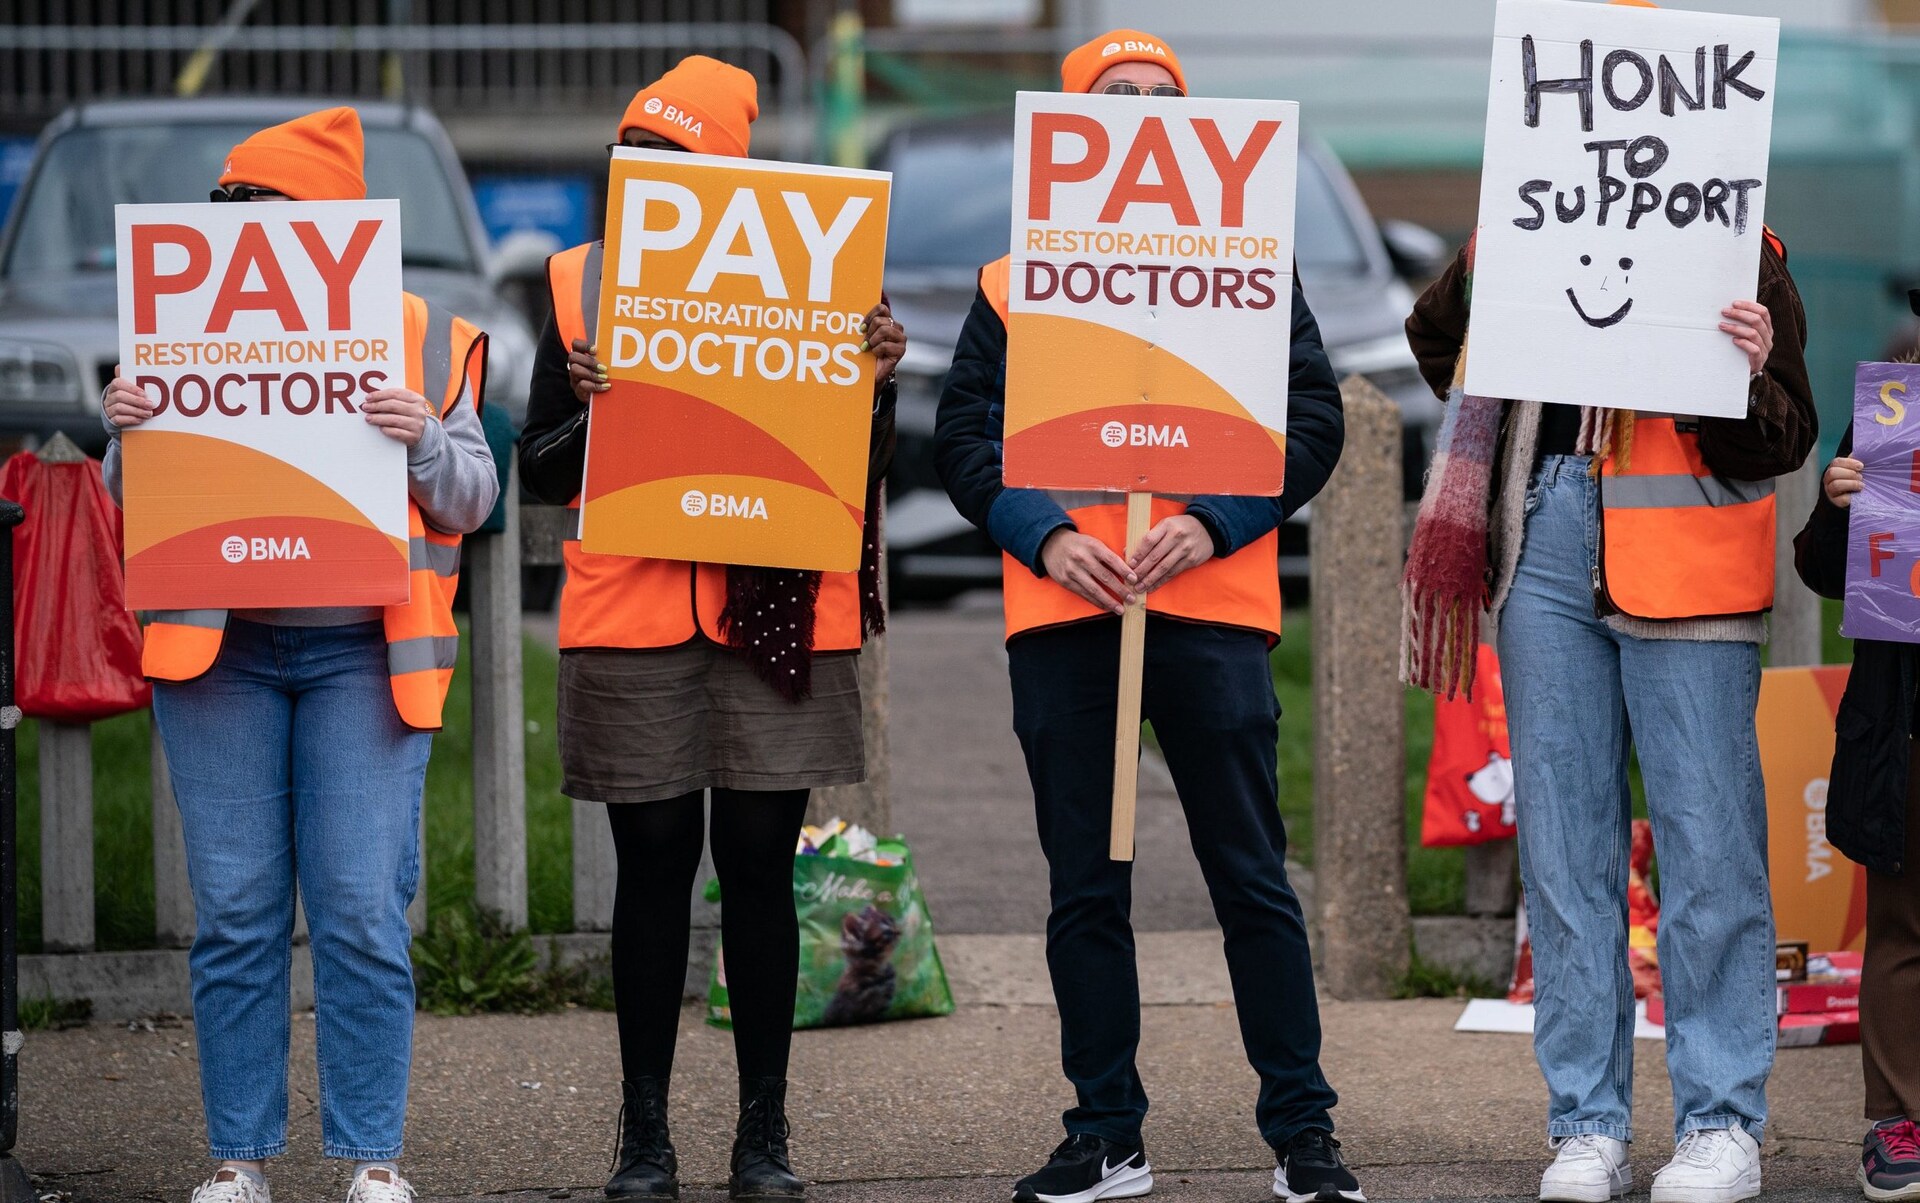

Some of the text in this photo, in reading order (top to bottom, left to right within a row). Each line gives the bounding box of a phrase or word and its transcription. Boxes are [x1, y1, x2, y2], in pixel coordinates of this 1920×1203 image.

[1124, 41, 1167, 57] BMA
[1521, 34, 1765, 132] HONK
[662, 105, 703, 138] BMA
[1028, 112, 1282, 228] PAY
[1583, 135, 1669, 179] TO
[1512, 177, 1762, 237] SUPPORT
[617, 178, 873, 303] PAY
[1026, 229, 1278, 260] RESTORATION FOR
[131, 220, 383, 335] PAY
[1025, 260, 1277, 311] DOCTORS
[614, 294, 867, 336] RESTORATION FOR
[135, 339, 389, 366] RESTORATION FOR
[610, 326, 862, 386] DOCTORS
[1130, 424, 1189, 448] BMA
[710, 494, 769, 520] BMA
[251, 537, 311, 561] BMA
[1806, 812, 1832, 882] BMA
